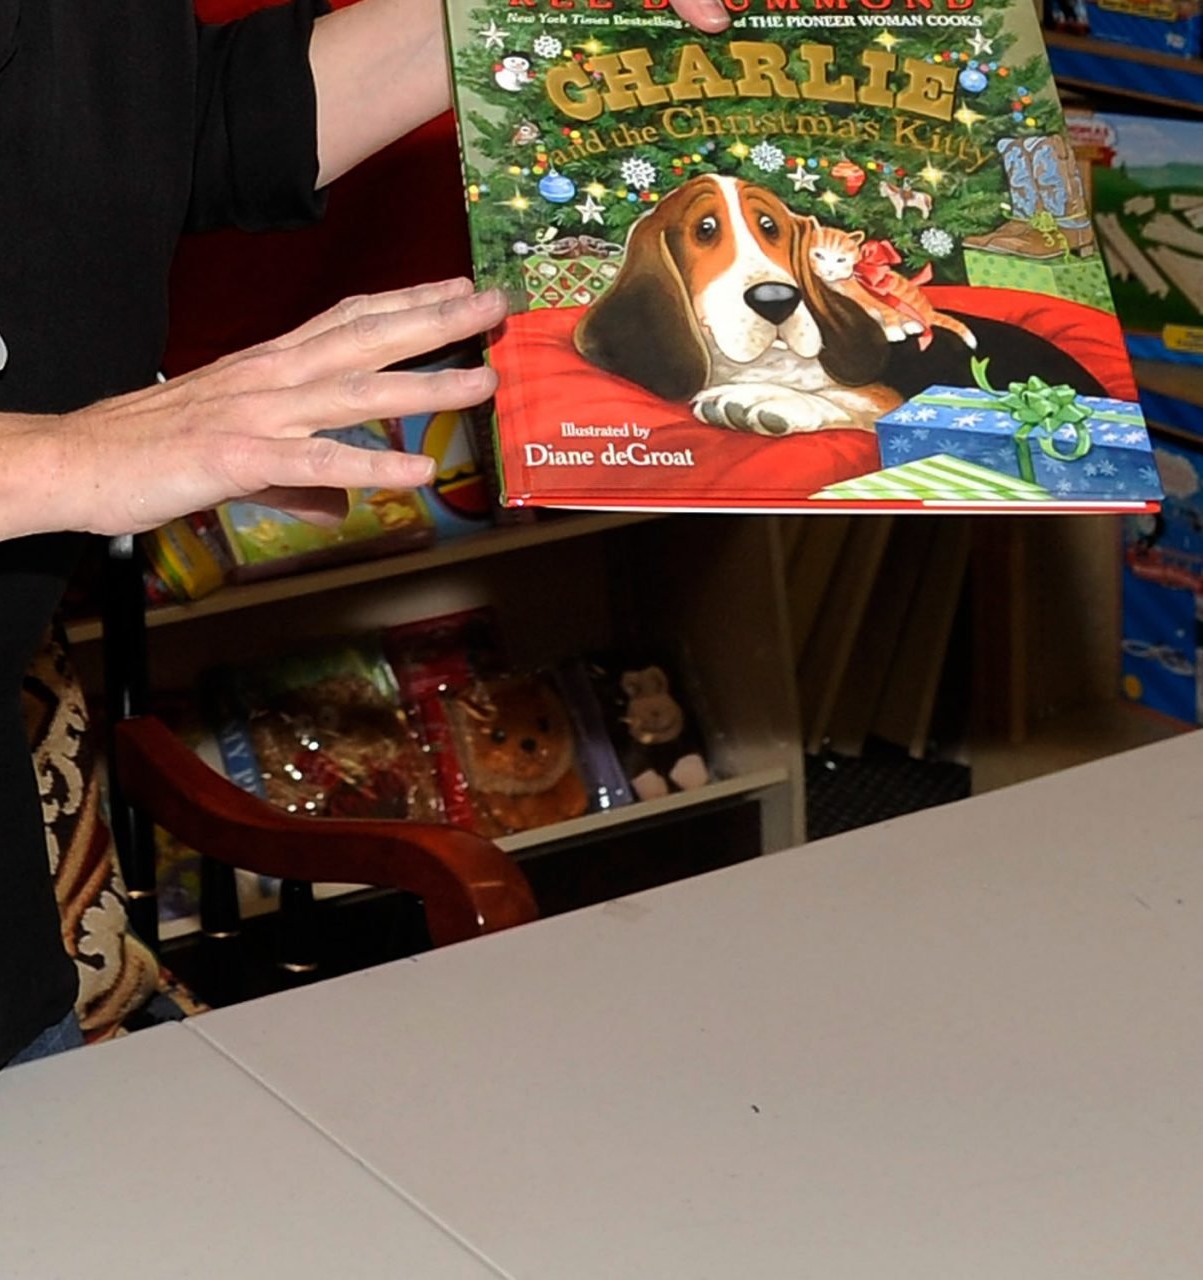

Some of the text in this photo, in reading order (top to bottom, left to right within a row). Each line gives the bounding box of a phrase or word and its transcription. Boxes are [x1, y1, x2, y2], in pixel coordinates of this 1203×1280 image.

[507, 13, 535, 24] New
[539, 13, 567, 24] York
[572, 13, 610, 25] Times
[613, 14, 683, 29] Bestselling
[749, 16, 784, 28] THE
[787, 16, 856, 28] PIONEER
[857, 15, 924, 27] WOMAN
[926, 15, 983, 27] COOKS
[546, 40, 960, 121] CHARLIE
[551, 106, 995, 173] and the Christmas Kitty
[561, 422, 651, 440] Illustrated by
[524, 442, 695, 467] Diane deGroat
